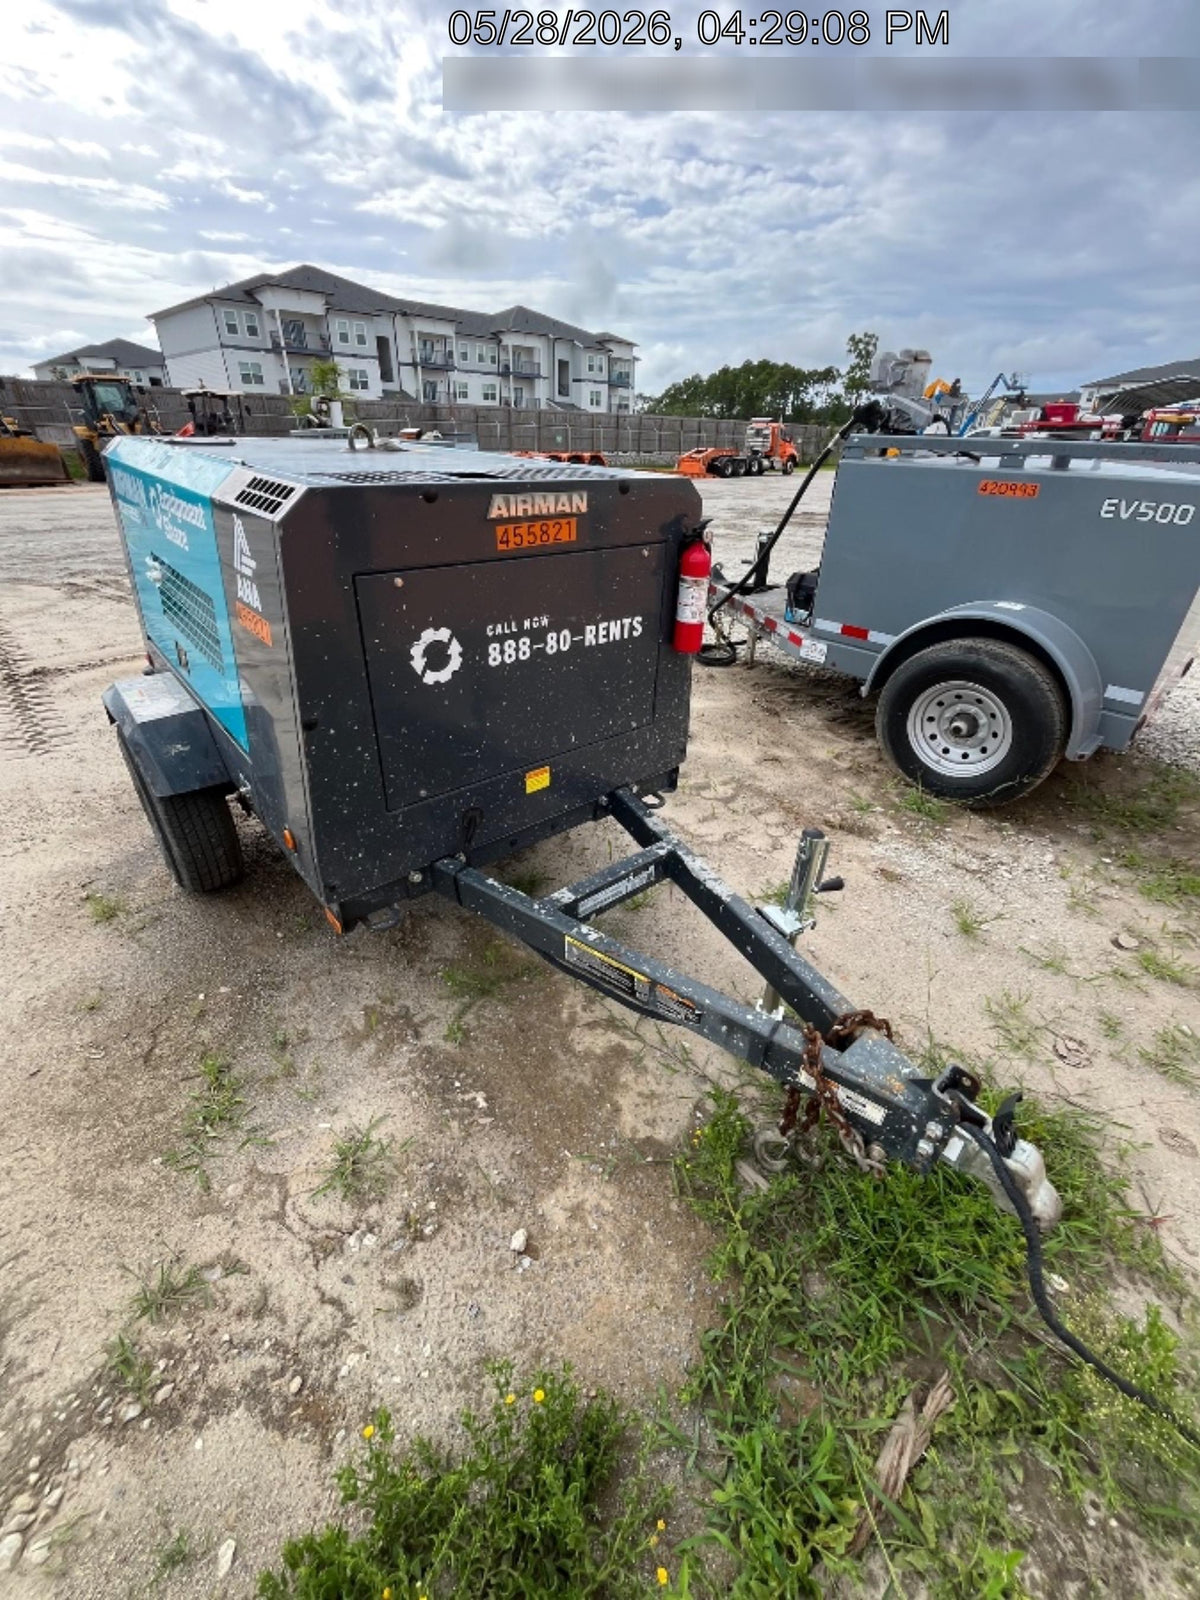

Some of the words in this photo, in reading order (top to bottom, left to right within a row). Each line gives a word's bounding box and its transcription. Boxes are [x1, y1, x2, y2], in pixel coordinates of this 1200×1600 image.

[980, 482, 1038, 497] 420993
[487, 491, 588, 520] AIRMAN
[1099, 498, 1196, 526] EV500
[499, 521, 573, 547] 455821
[486, 621, 518, 637] CALL
[523, 614, 550, 630] NOW
[488, 617, 643, 667] 888-80-RENTS
